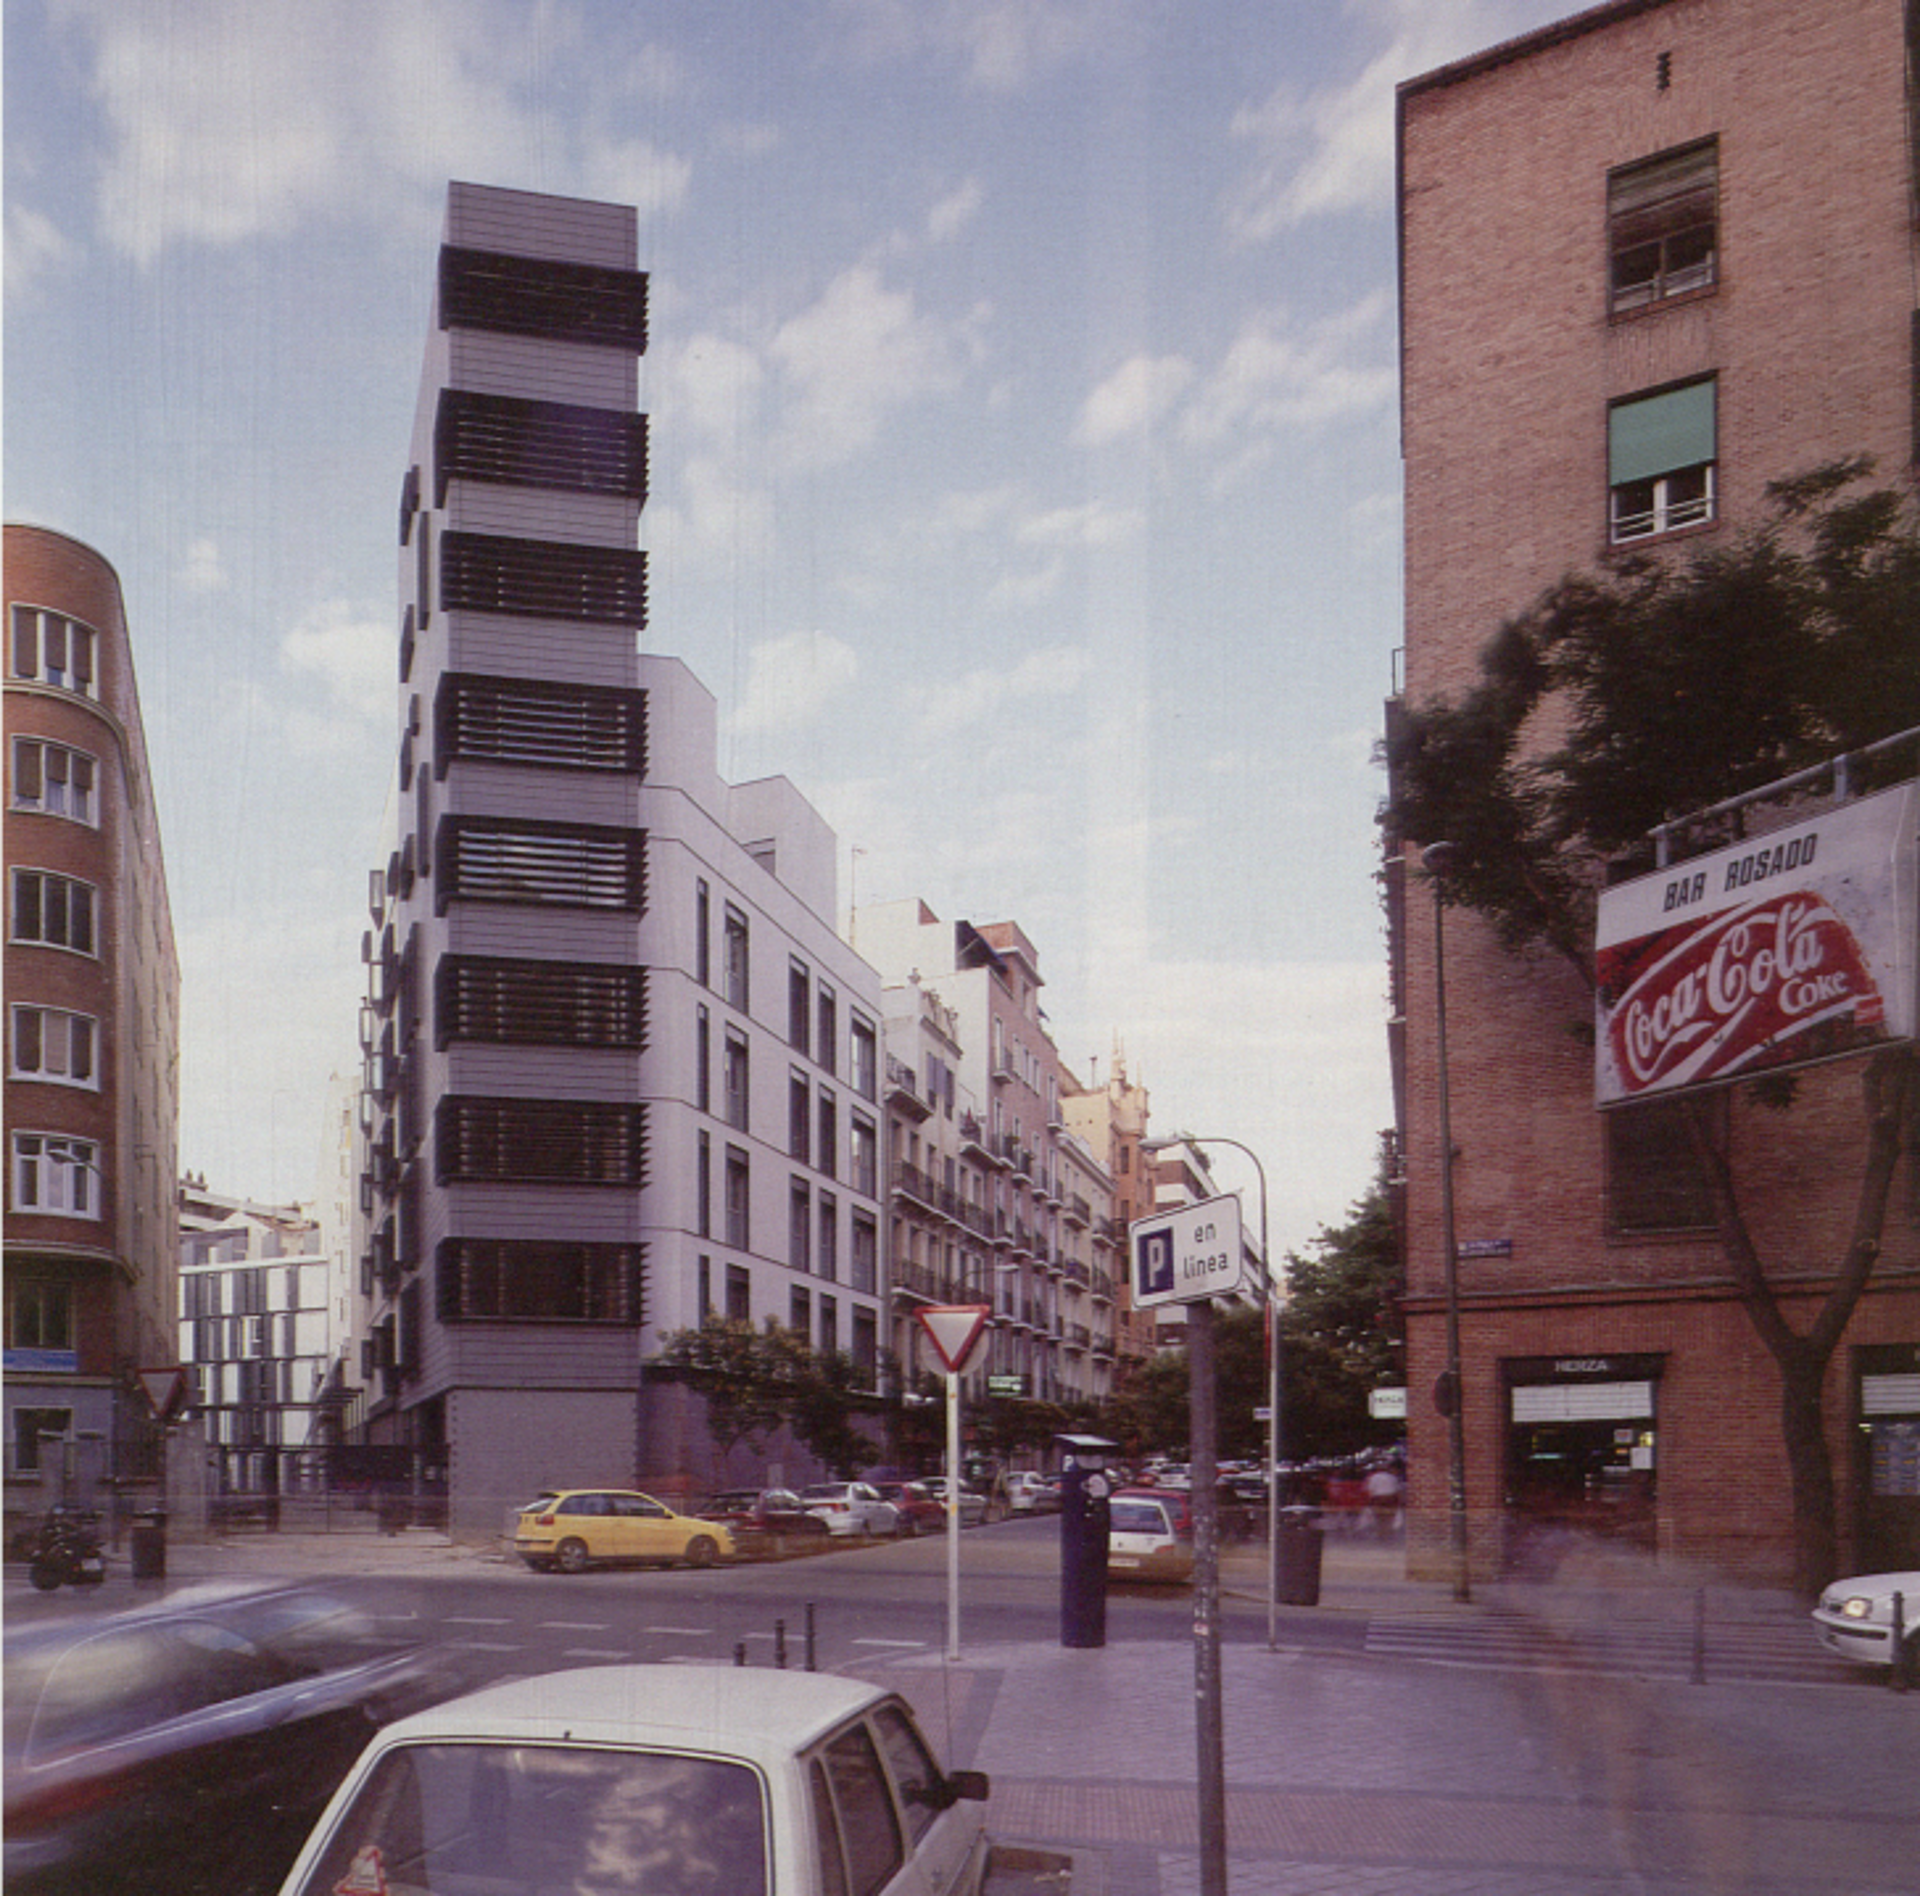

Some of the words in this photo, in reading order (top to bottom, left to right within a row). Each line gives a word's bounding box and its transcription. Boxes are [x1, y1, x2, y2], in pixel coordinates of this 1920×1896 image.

[1663, 872, 1706, 912] BAR
[1724, 833, 1818, 892] ROSADO
[1624, 901, 1825, 1081] Coca-Cola
[1779, 970, 1848, 1015] Coke
[1194, 1223, 1216, 1242] en
[1147, 1238, 1164, 1287] P
